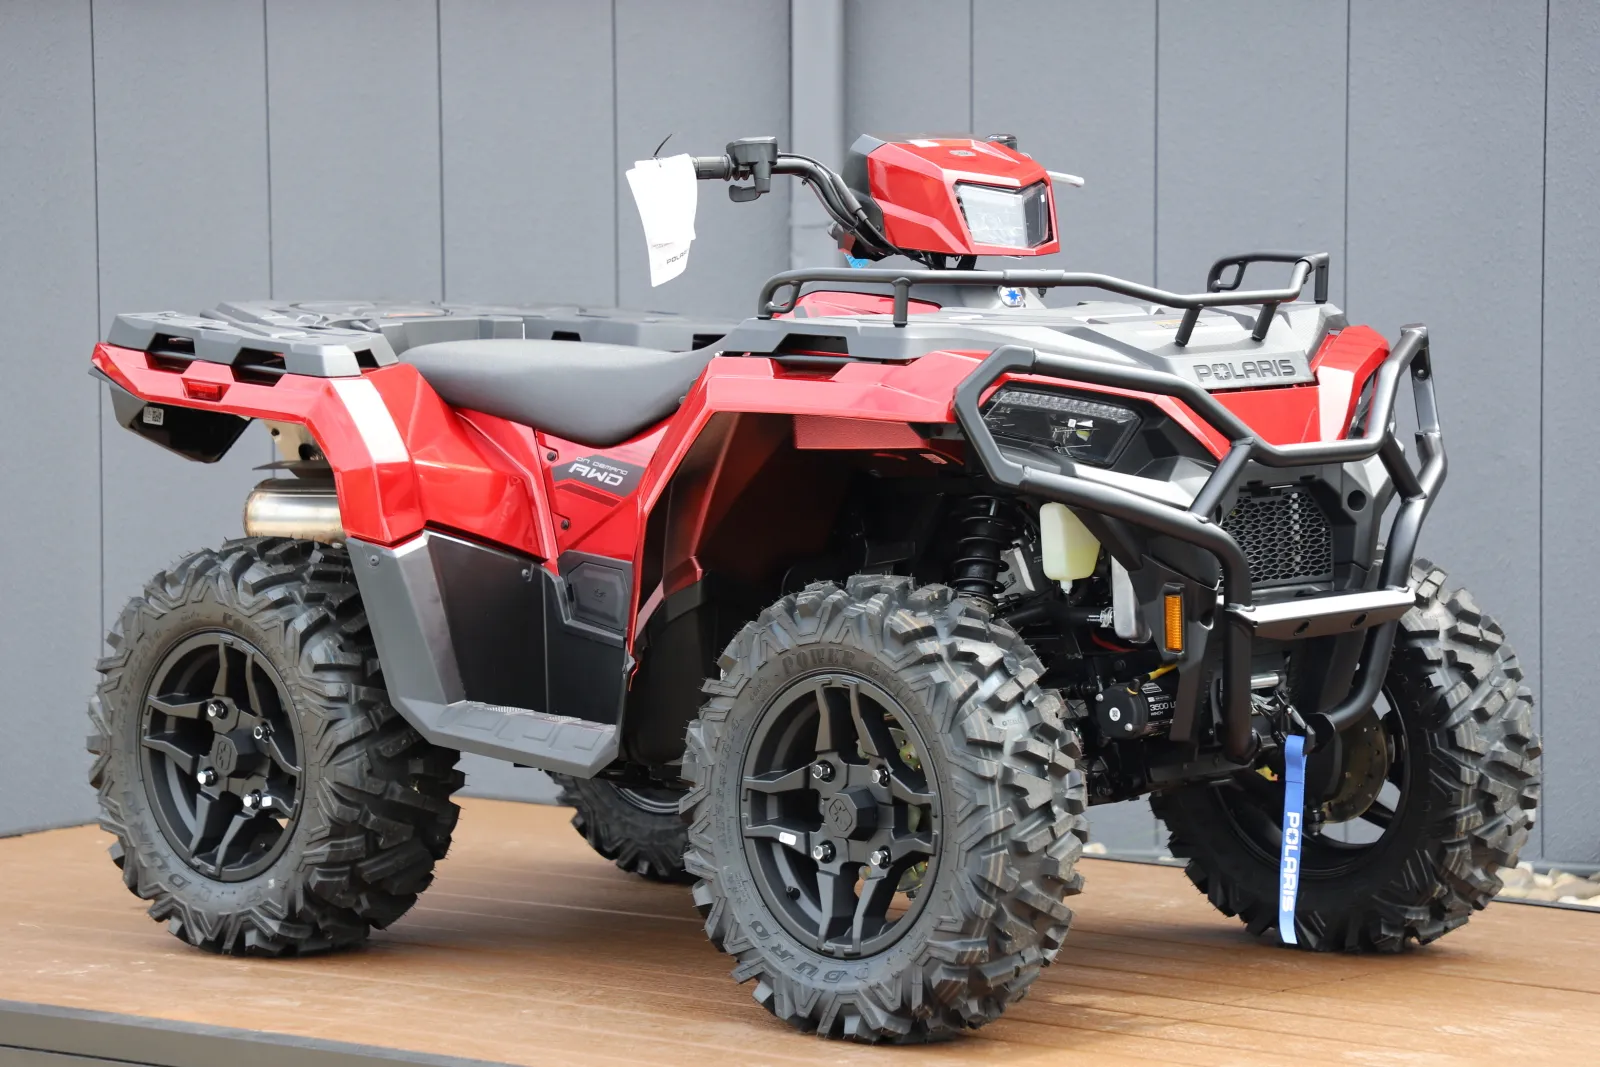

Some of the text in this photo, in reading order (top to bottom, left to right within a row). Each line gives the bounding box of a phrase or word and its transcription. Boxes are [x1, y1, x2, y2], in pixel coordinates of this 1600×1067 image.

[1192, 359, 1296, 382] POLARIS
[568, 462, 624, 486] AWD
[1149, 702, 1170, 711] 3500
[1281, 811, 1301, 913] POLARIS
[748, 920, 849, 984] DURO
